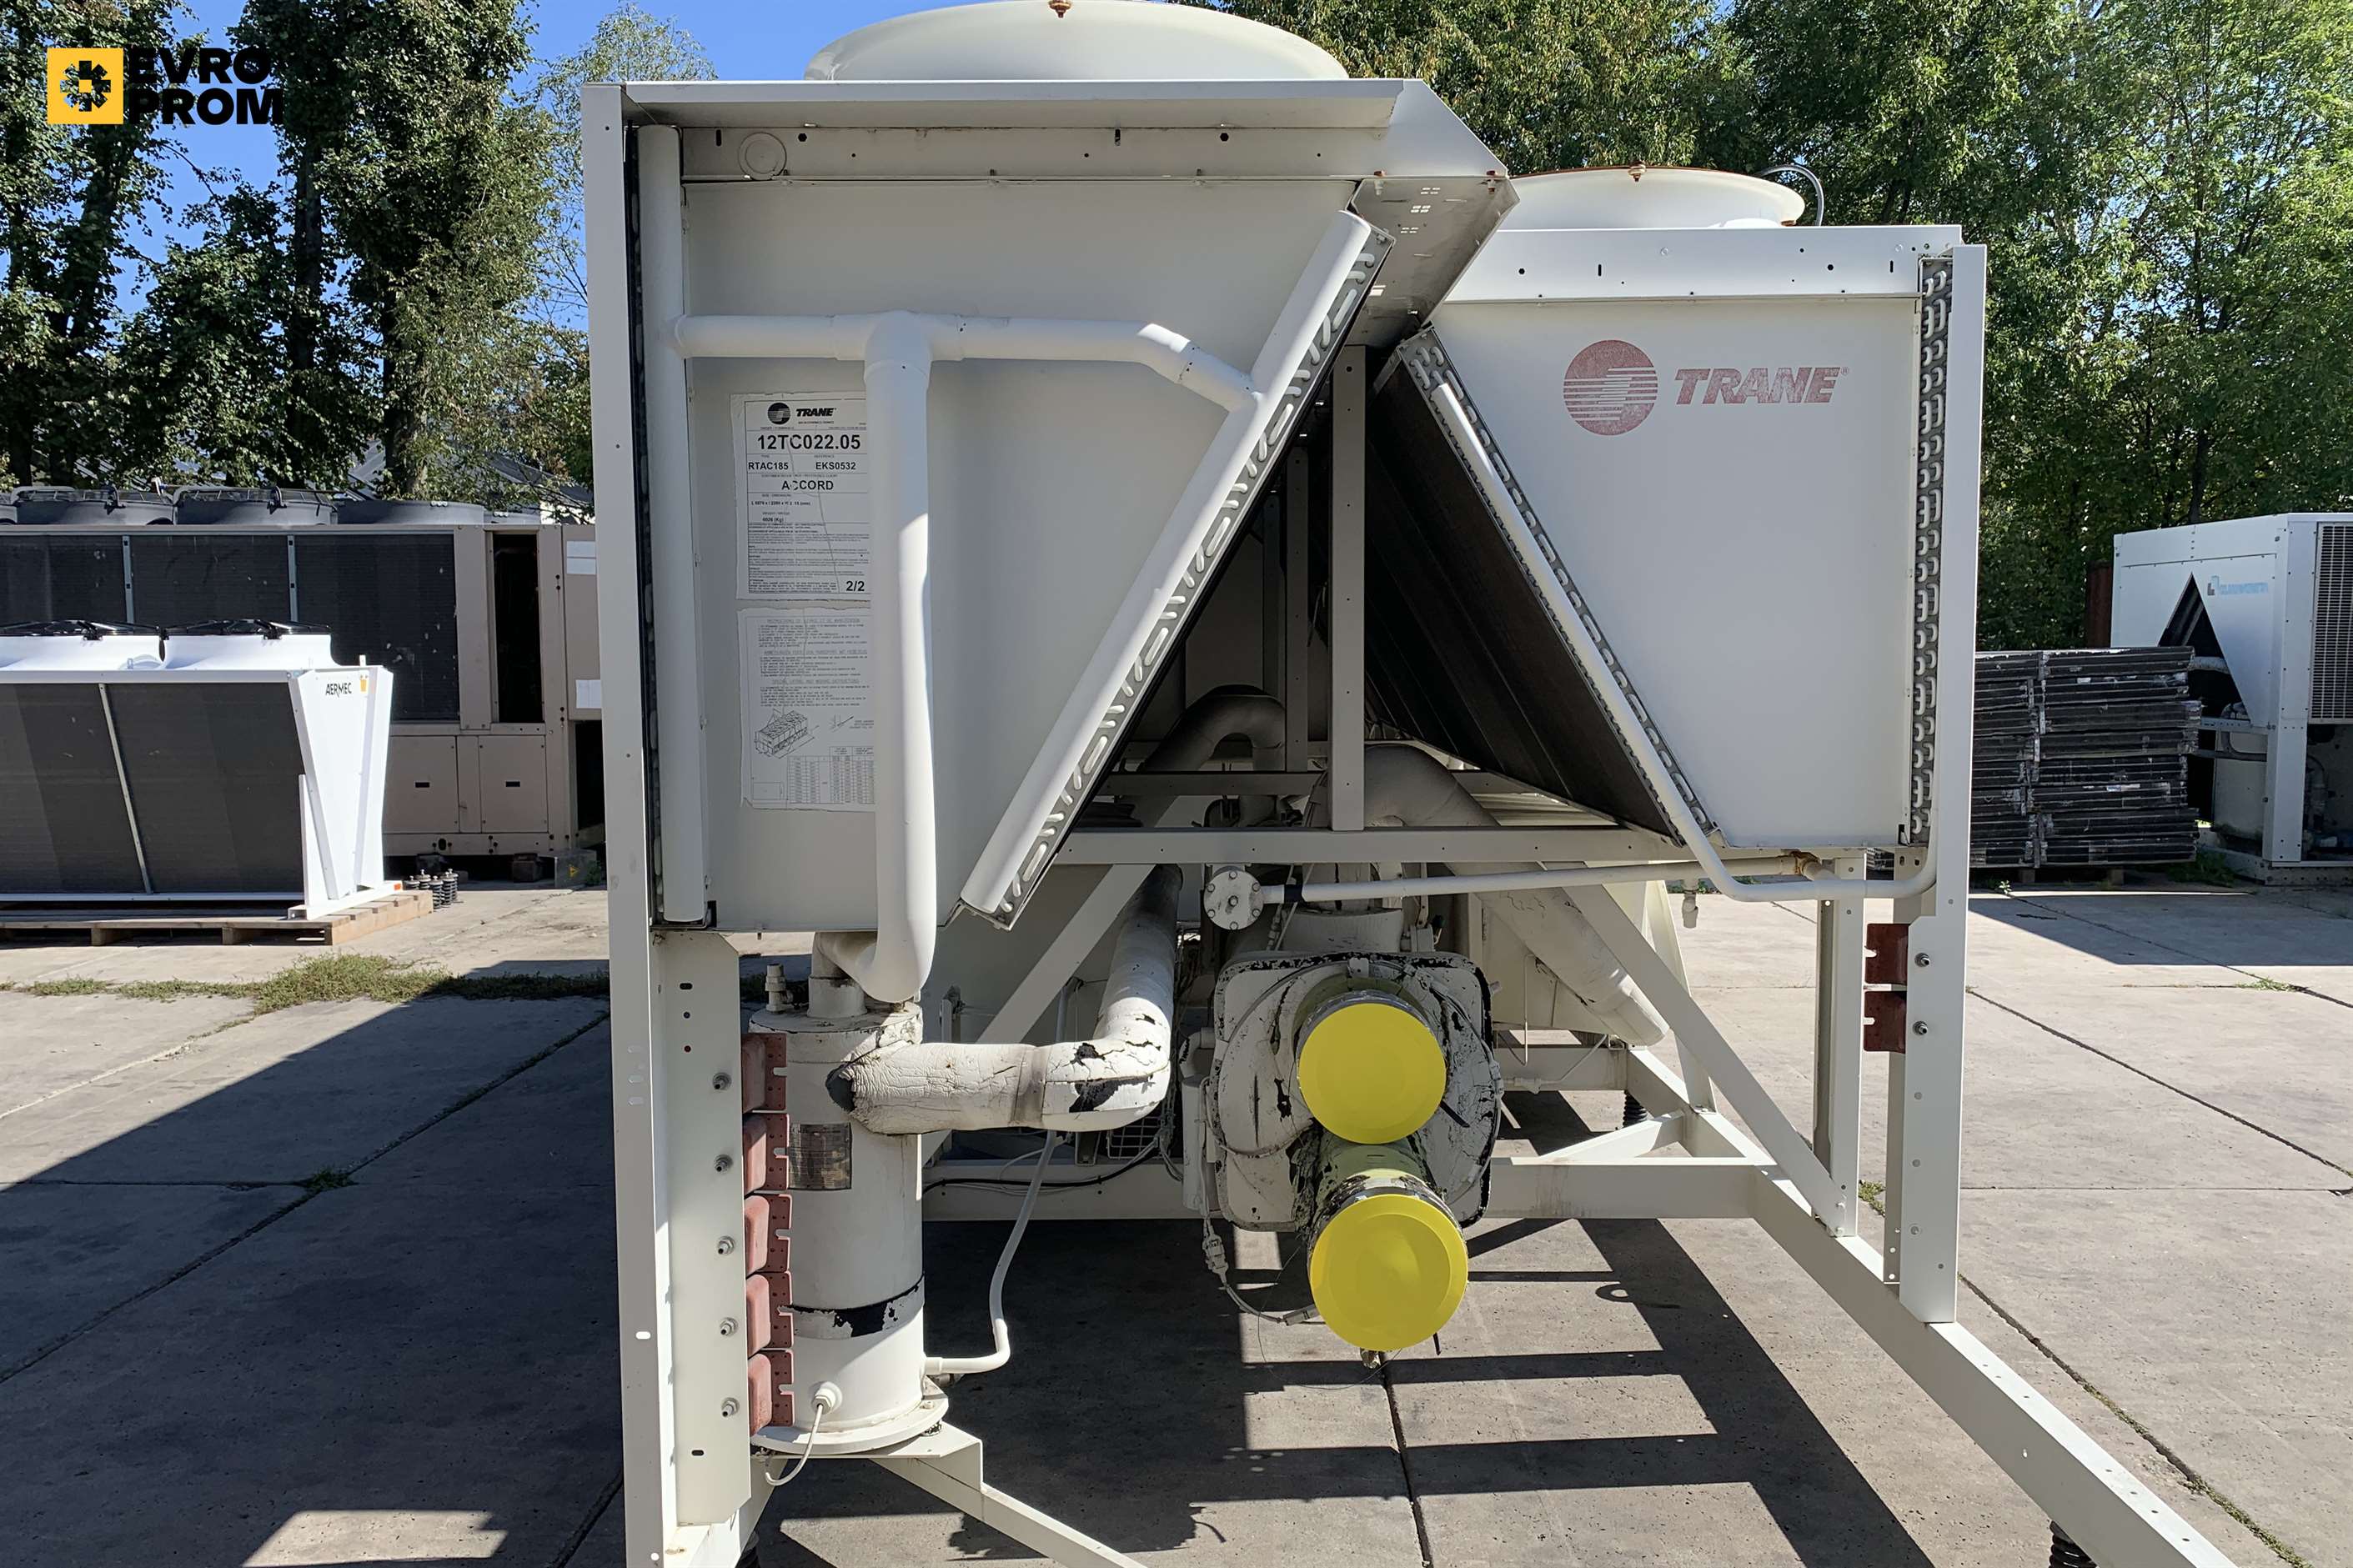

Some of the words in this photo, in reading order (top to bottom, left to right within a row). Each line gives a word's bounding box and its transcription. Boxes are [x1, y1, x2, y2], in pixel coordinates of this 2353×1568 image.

[757, 434, 860, 449] 12TC022.05
[748, 461, 789, 470] RTAC185
[815, 461, 856, 470] EKS0532
[781, 480, 834, 490] ACCORD
[845, 580, 865, 592] 2/2
[325, 682, 352, 698] AERMEC
